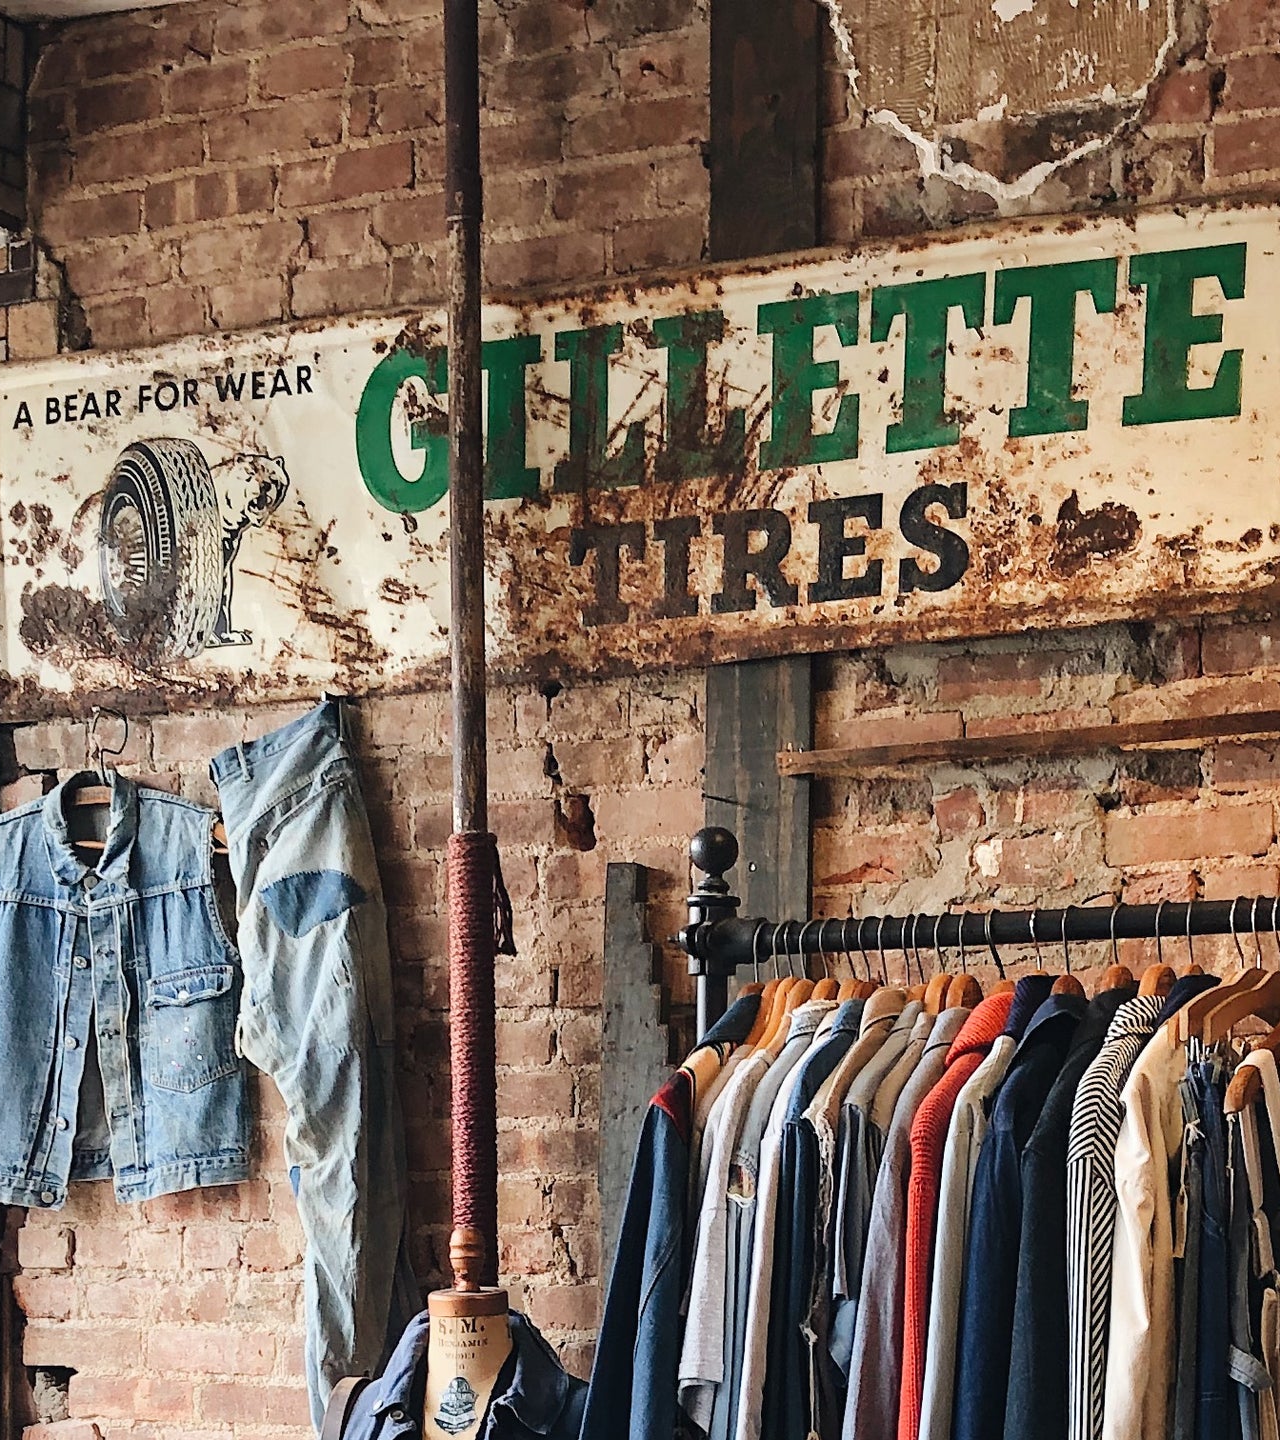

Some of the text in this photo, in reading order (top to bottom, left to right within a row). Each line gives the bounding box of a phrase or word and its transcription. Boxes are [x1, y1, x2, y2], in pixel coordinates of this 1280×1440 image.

[13, 365, 313, 430] A BEAR FOR WEAR
[356, 242, 1247, 513] GILLETTE
[570, 482, 970, 627] TIRES
